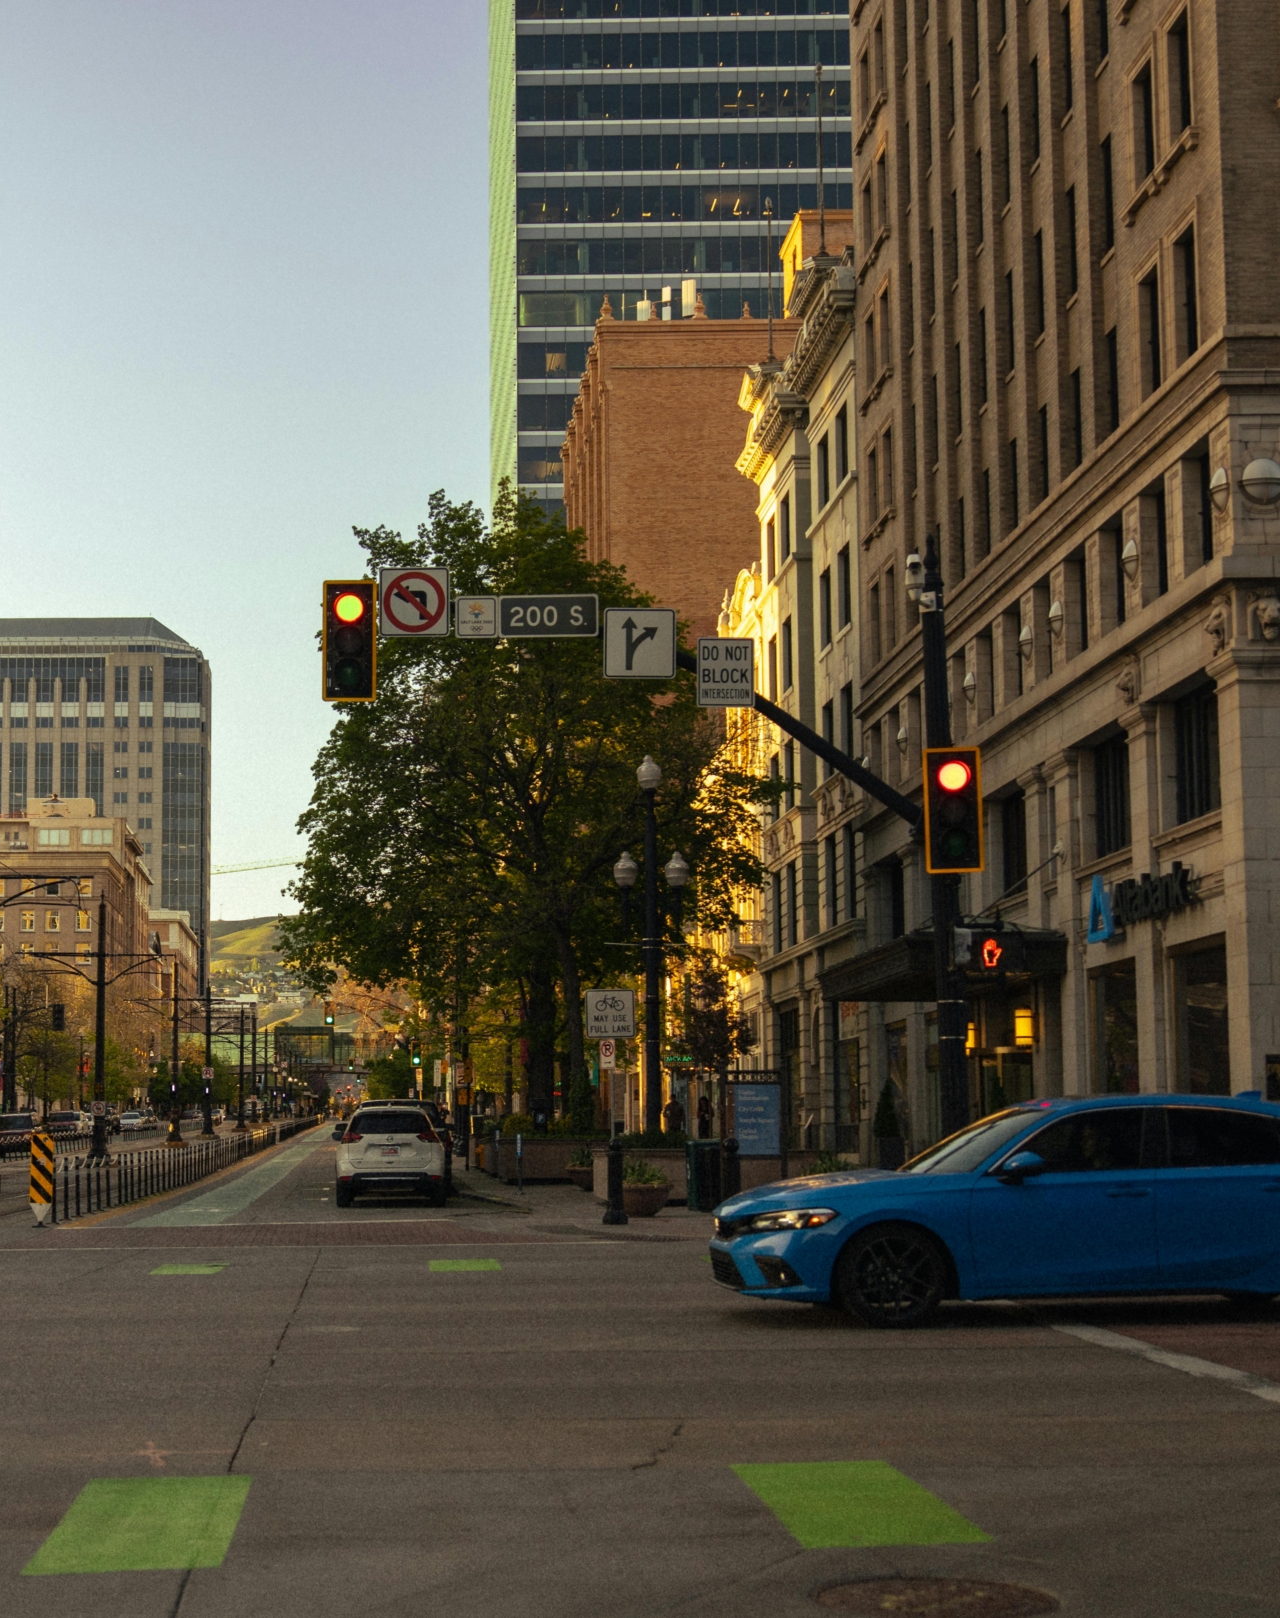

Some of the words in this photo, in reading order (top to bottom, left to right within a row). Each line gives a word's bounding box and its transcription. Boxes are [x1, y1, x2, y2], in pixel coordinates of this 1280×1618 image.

[510, 605, 558, 627] 200
[569, 605, 588, 626] S.
[702, 645, 719, 661] DO
[725, 645, 749, 661] NOT
[702, 668, 749, 684] BLOCK
[701, 688, 750, 699] INTERSECTION
[593, 1014, 609, 1022] MAY
[612, 1014, 627, 1022] USE
[590, 1025, 609, 1033] FULL
[612, 1025, 631, 1033] LANE
